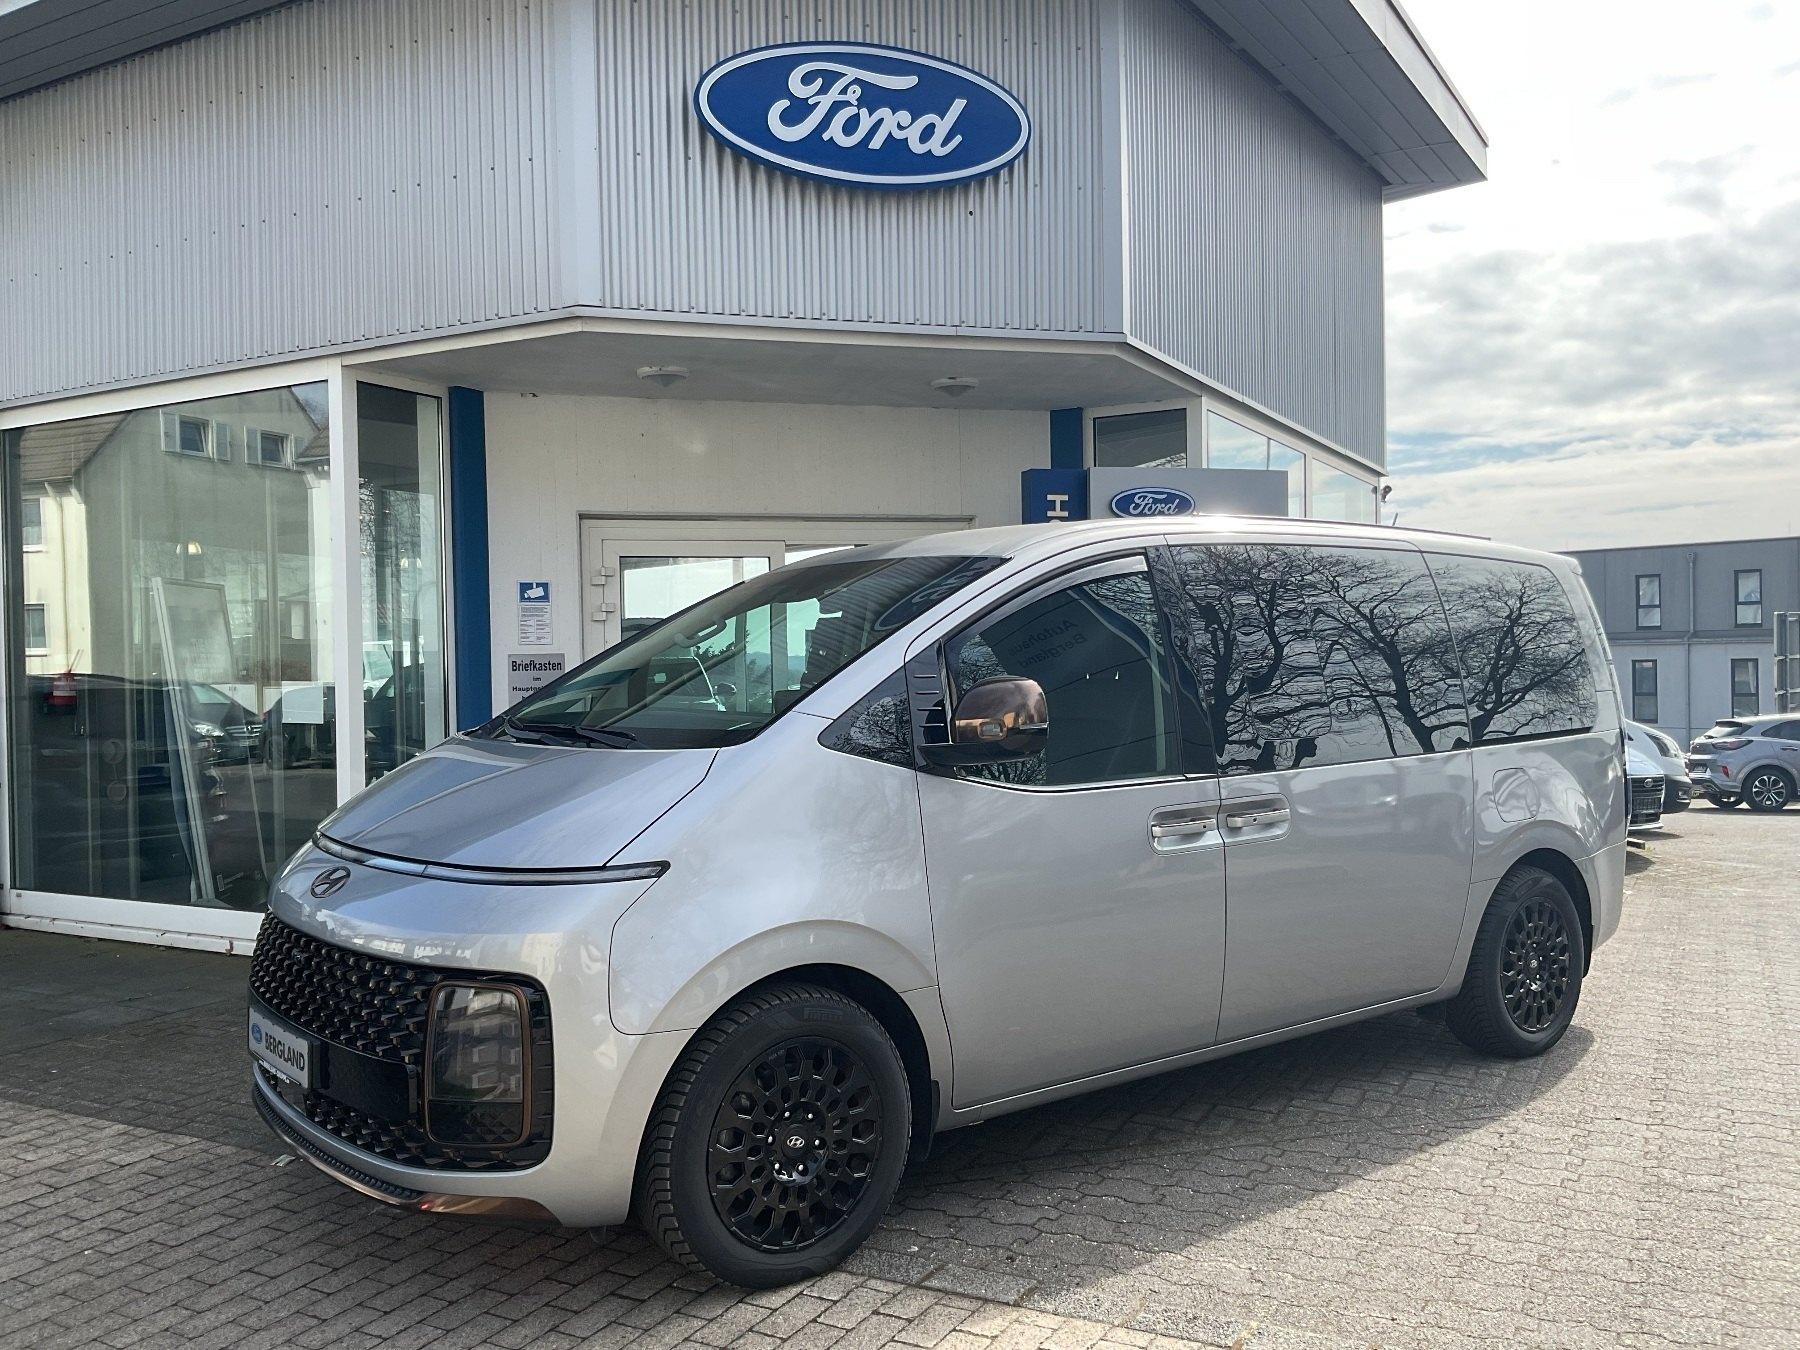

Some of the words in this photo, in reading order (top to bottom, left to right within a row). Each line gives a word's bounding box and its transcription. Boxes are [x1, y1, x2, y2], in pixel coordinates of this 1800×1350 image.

[767, 61, 968, 157] Ford
[1129, 493, 1179, 515] Ford
[511, 660, 562, 672] Briefkasten
[264, 1032, 305, 1071] BERGLAND
